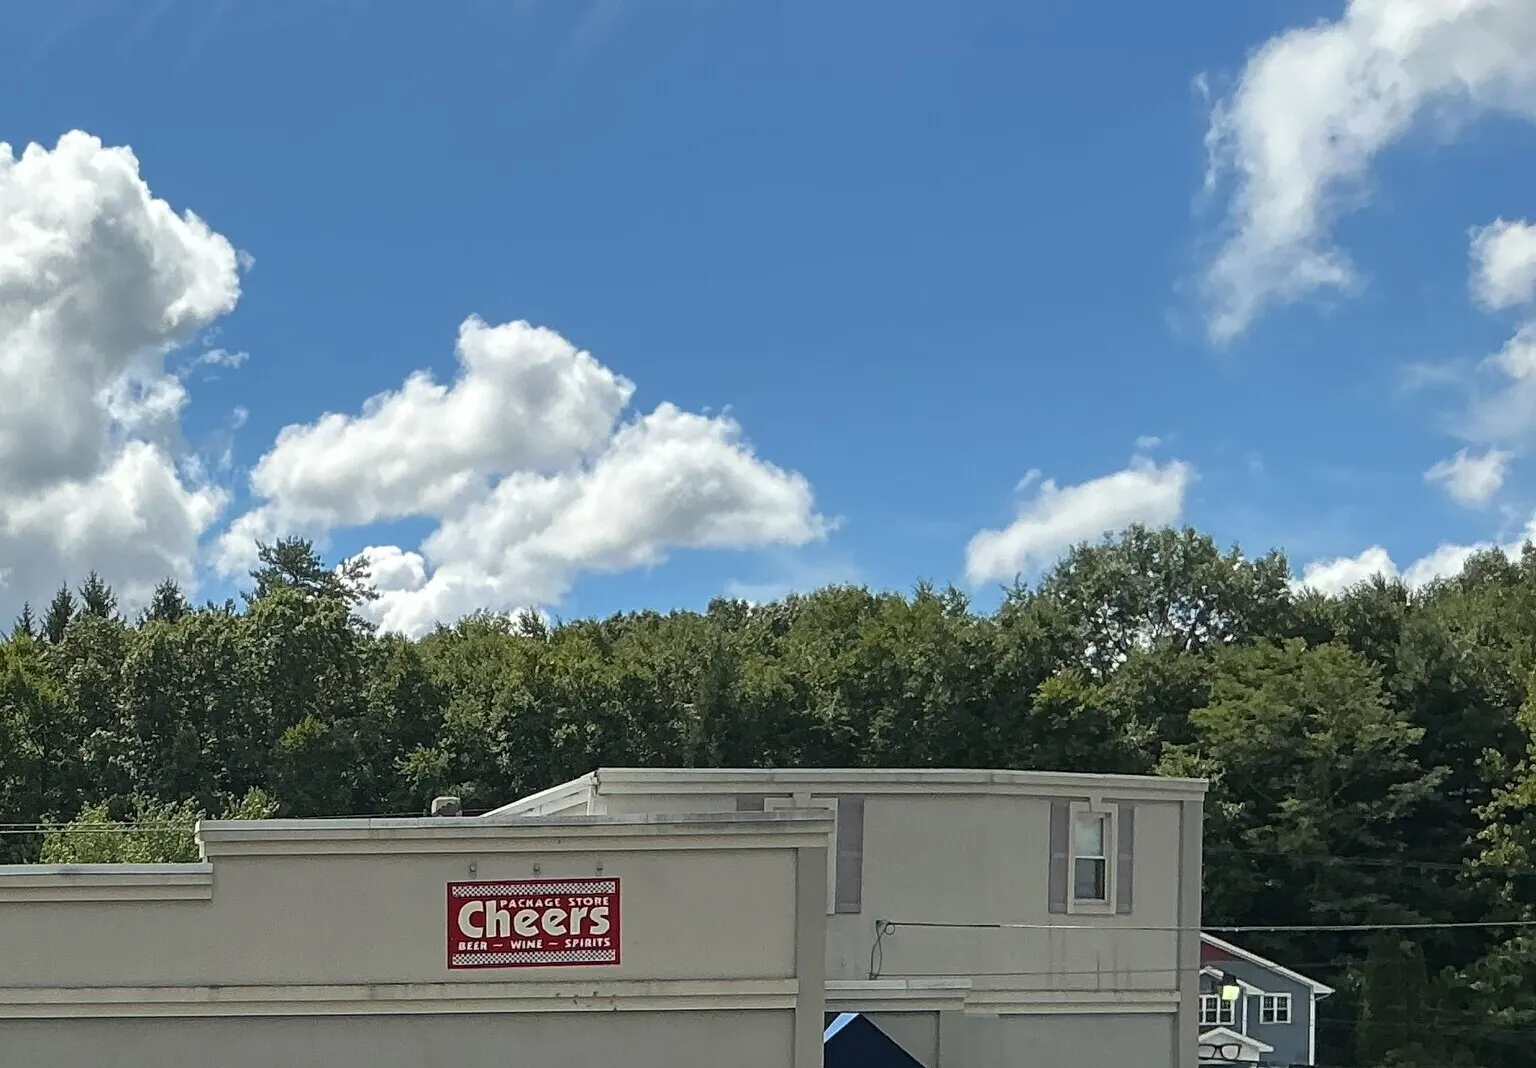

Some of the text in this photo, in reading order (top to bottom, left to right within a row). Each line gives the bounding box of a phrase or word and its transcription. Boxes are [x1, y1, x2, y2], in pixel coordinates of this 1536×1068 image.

[499, 897, 609, 908] PACKAGE STORE
[458, 900, 610, 938] Cheers
[458, 937, 611, 951] BEER WINE SPIRITS
